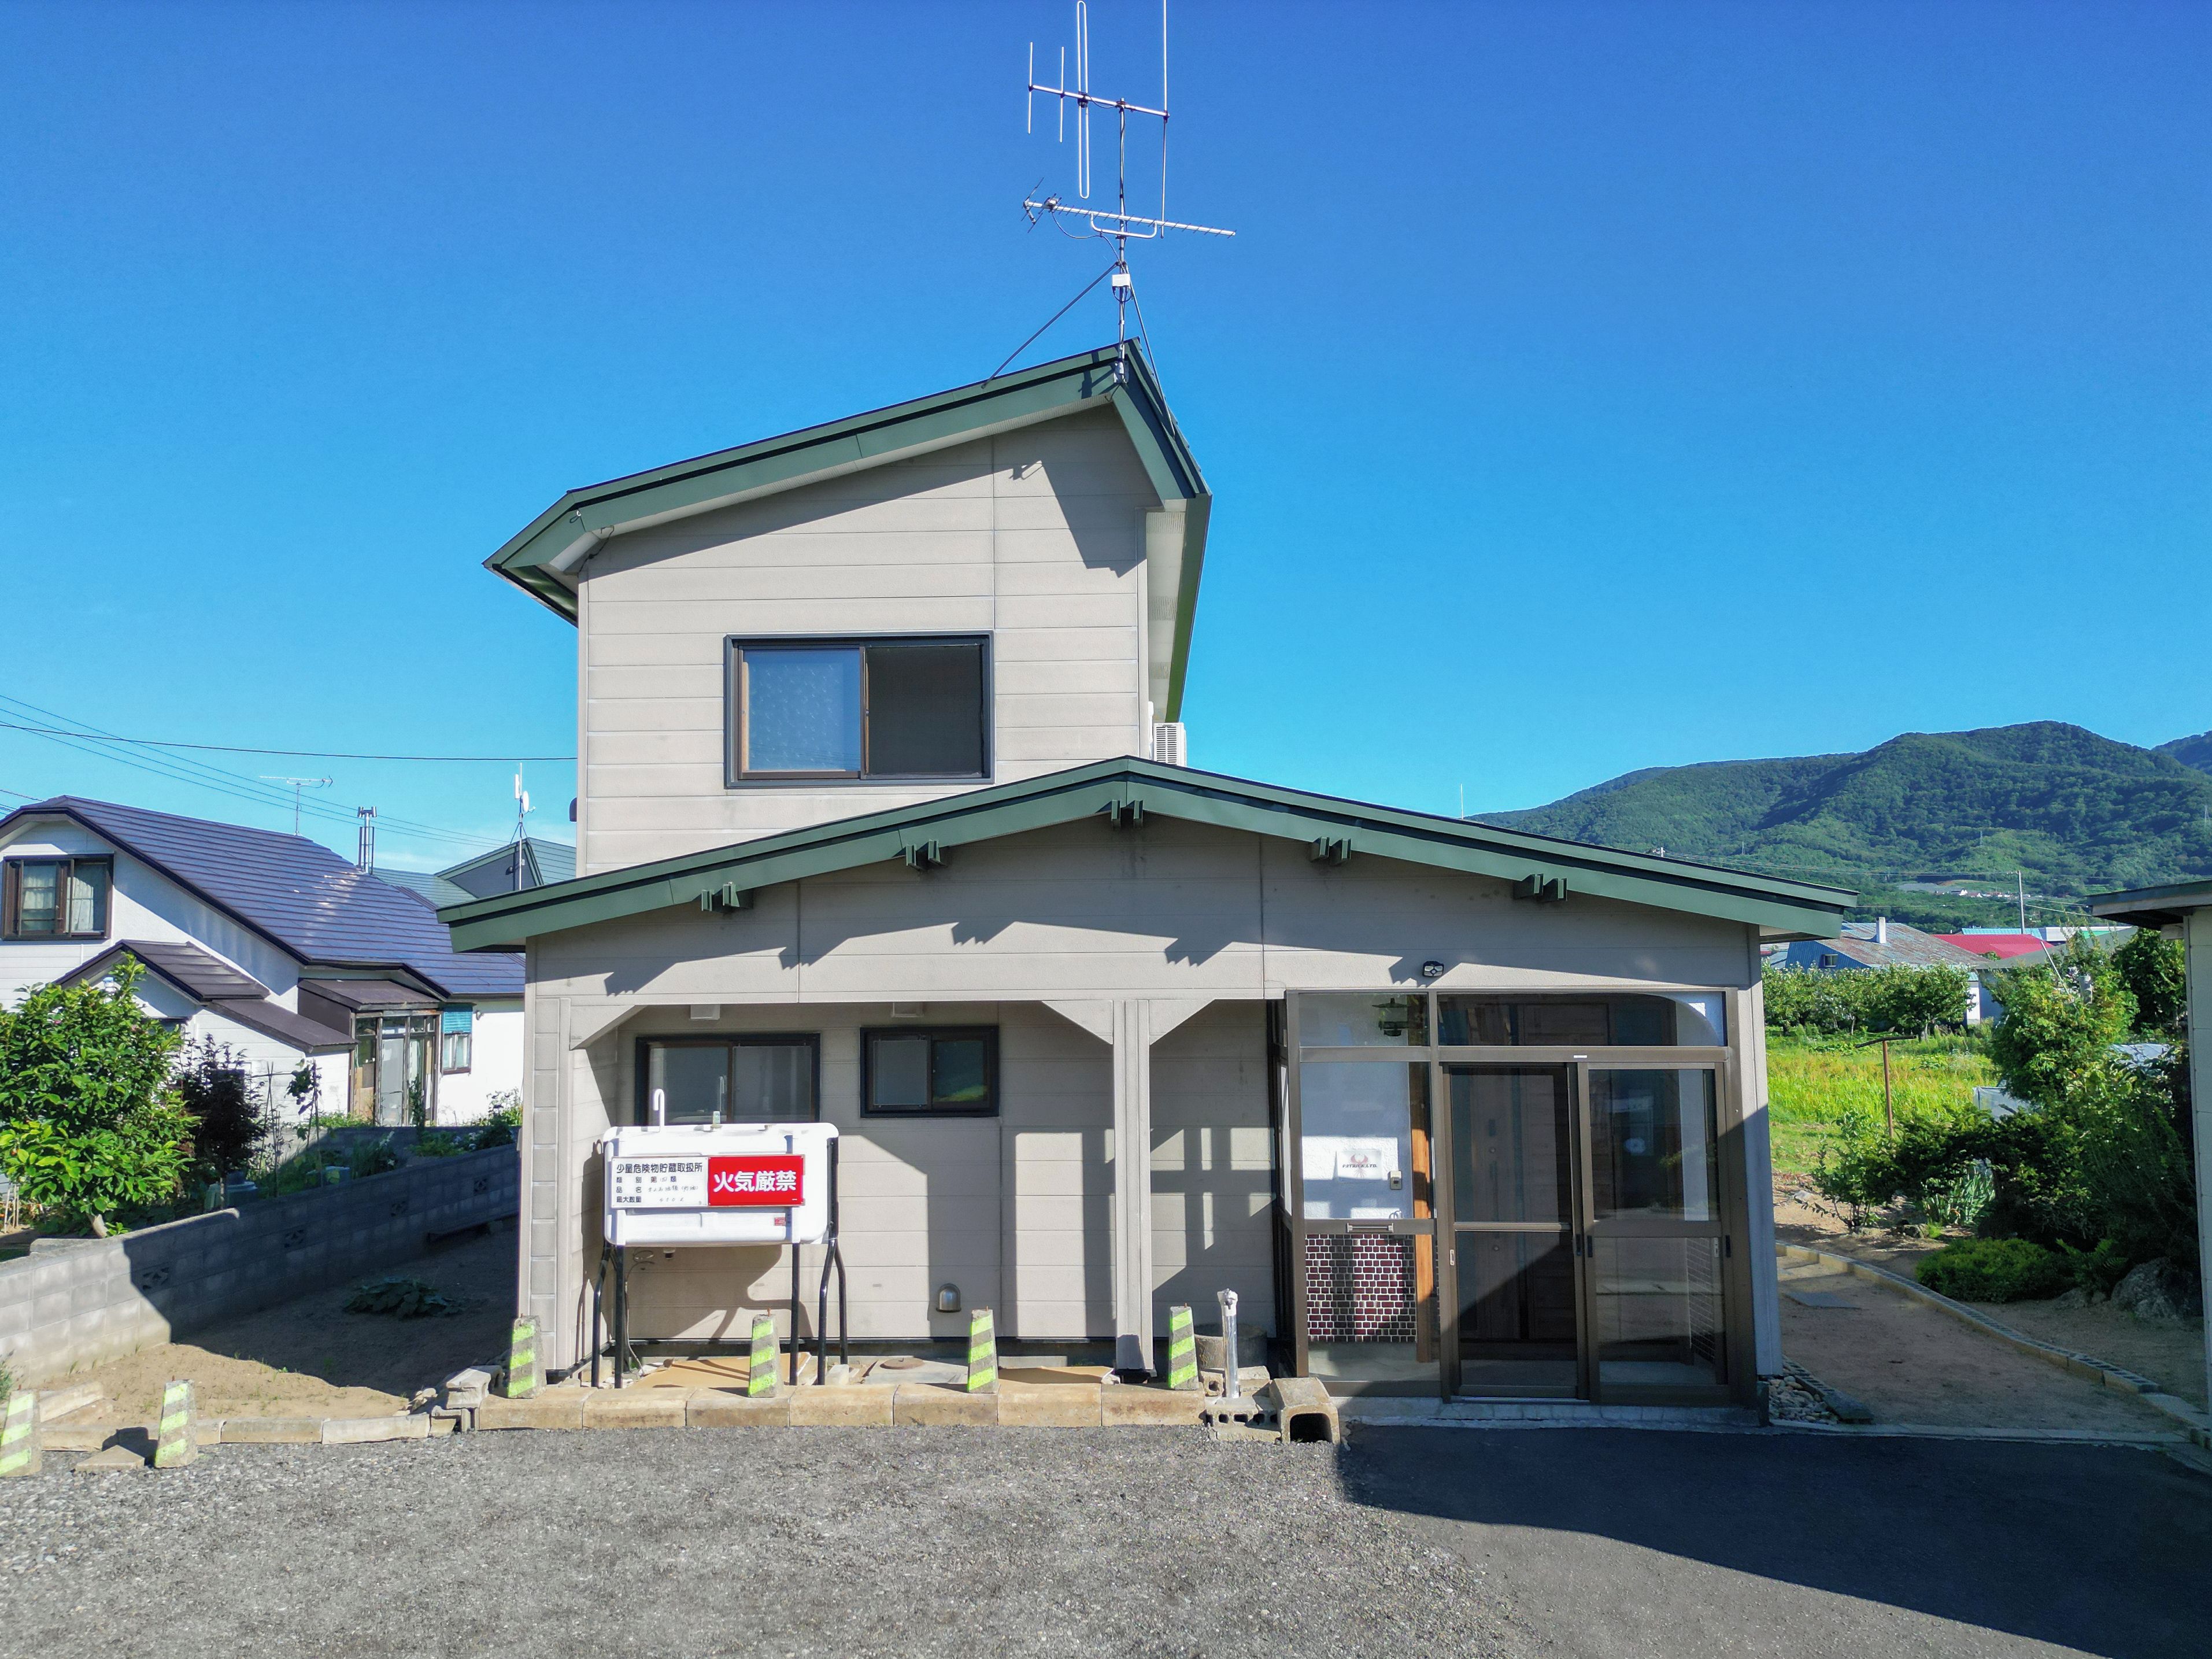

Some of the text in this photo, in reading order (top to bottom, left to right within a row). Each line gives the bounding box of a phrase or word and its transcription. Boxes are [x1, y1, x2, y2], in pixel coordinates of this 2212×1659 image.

[616, 1162, 702, 1174] 少量危険物貯蔵取扱所
[713, 1170, 797, 1192] 火気厳禁
